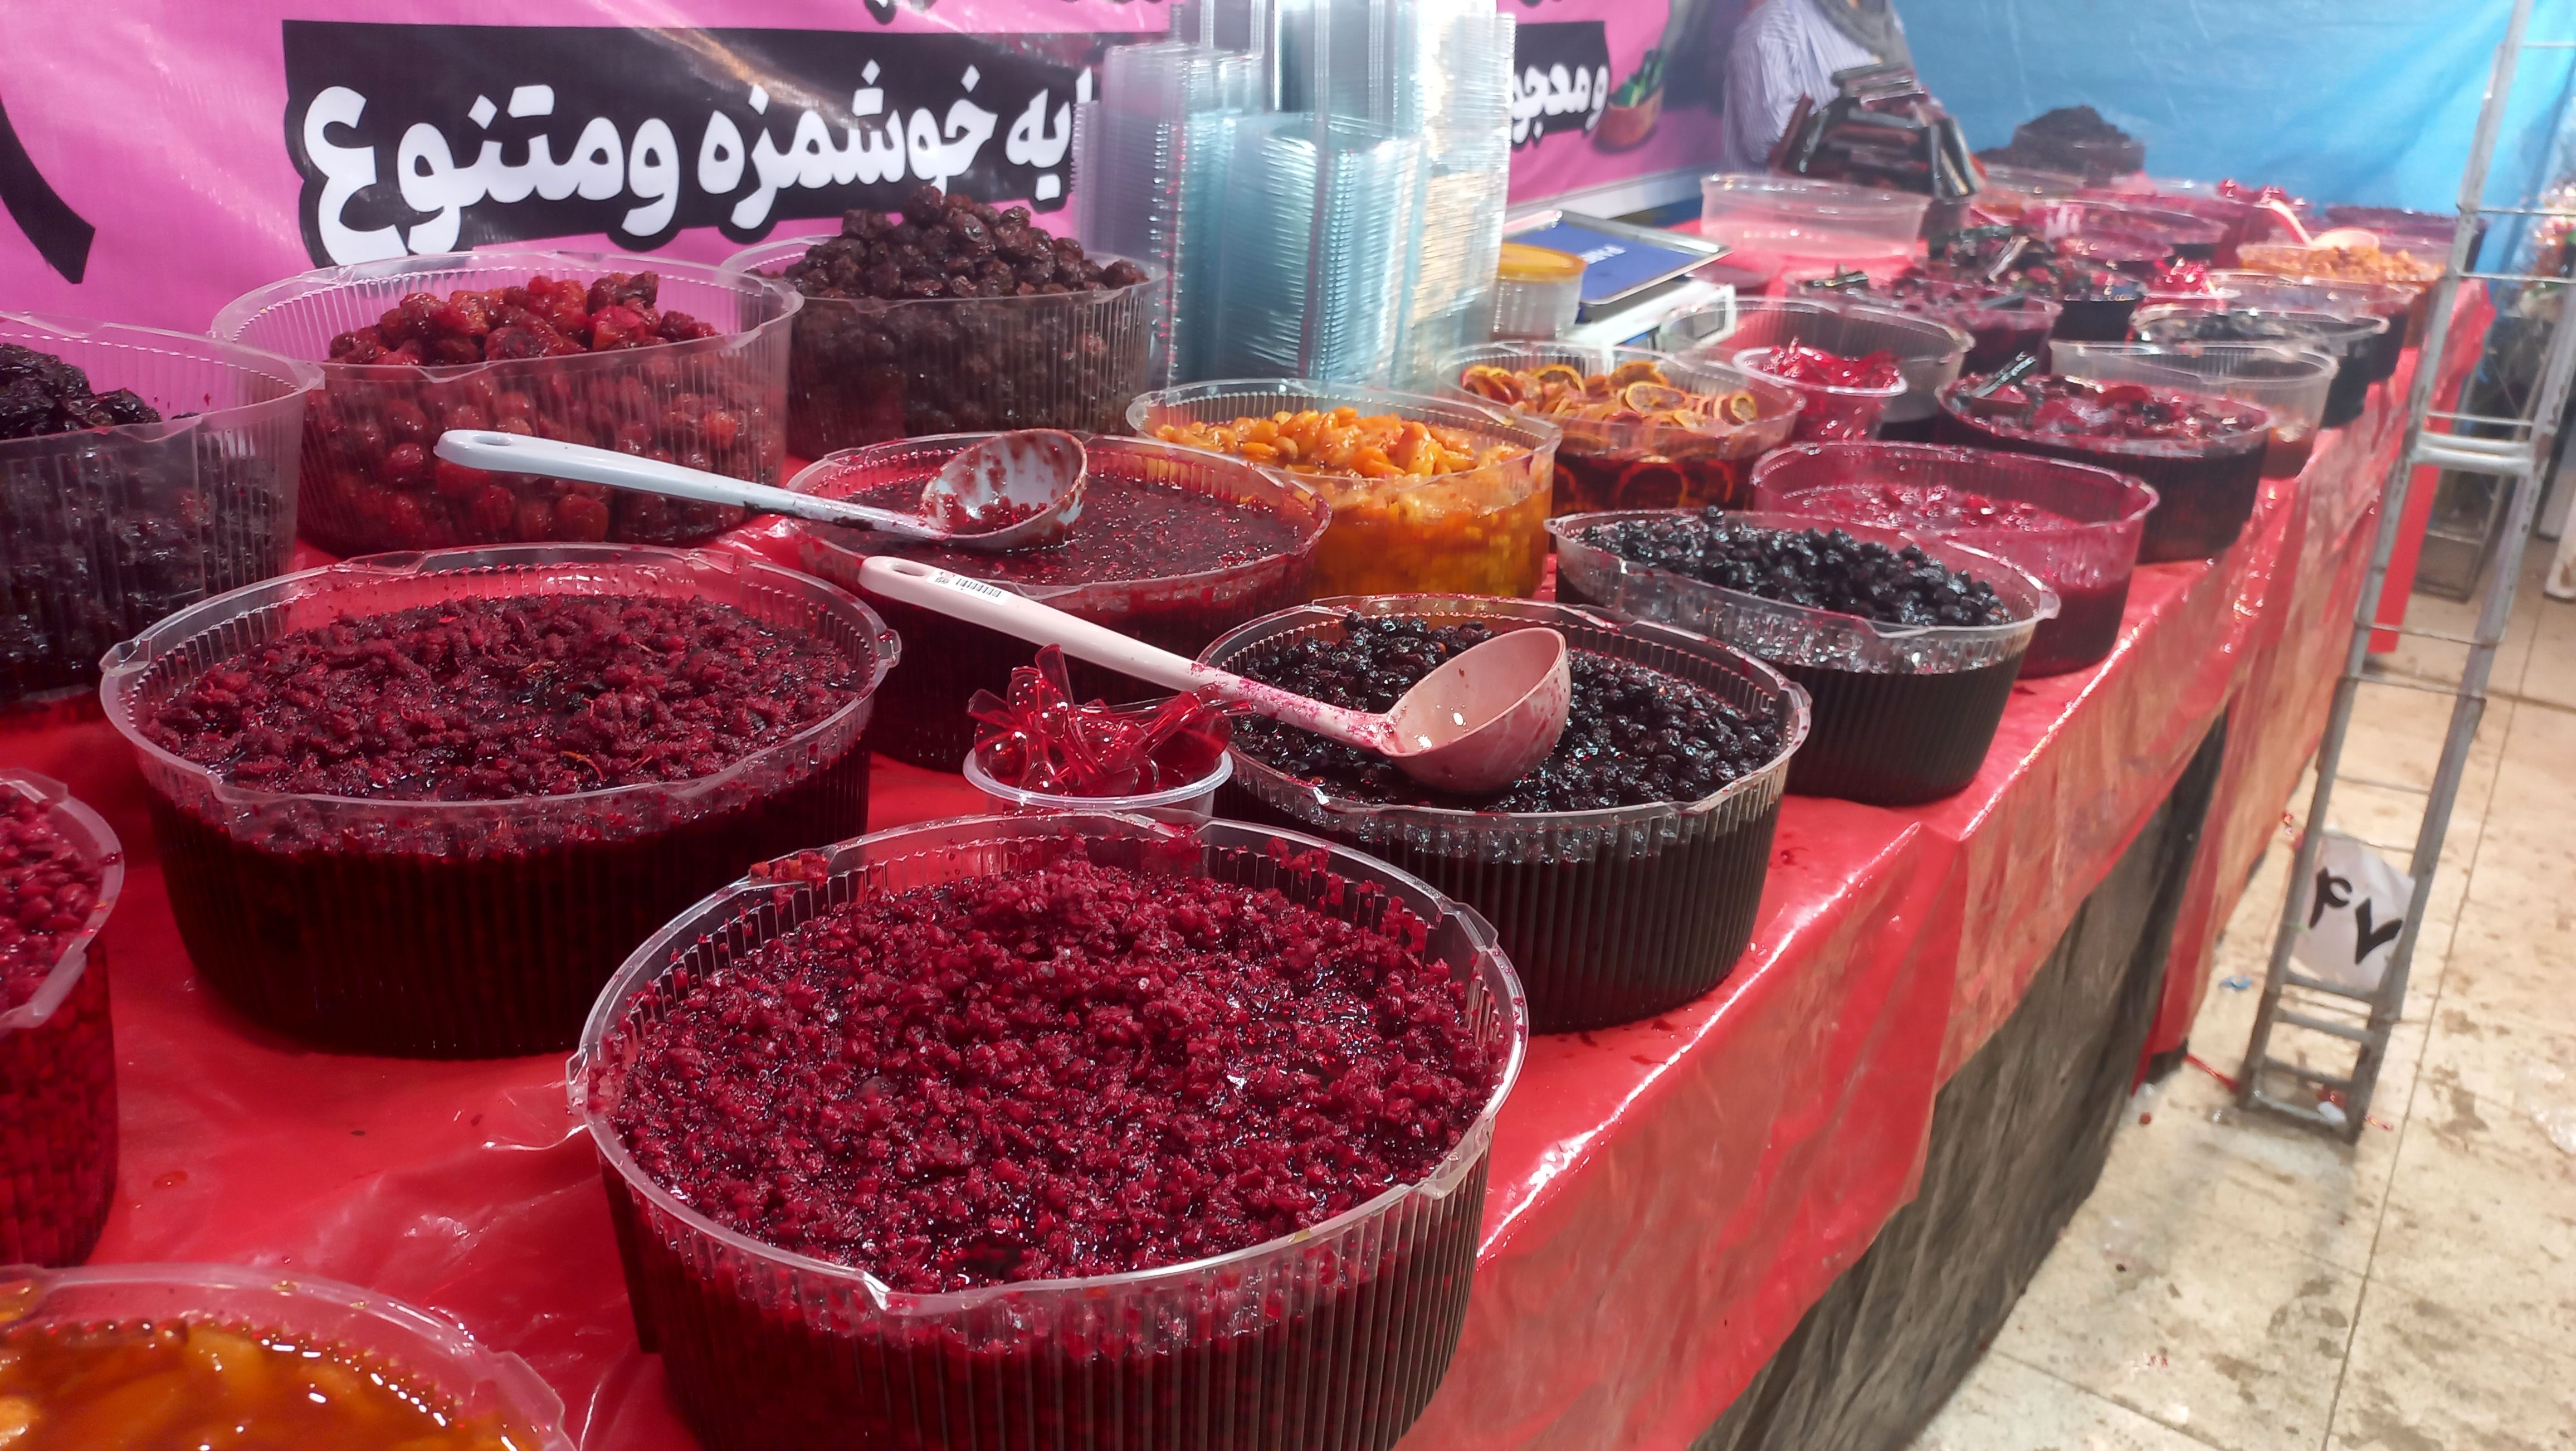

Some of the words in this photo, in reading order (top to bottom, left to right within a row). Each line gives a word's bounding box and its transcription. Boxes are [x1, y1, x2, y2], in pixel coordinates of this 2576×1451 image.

[304, 84, 680, 266] ومتنوع
[697, 58, 998, 230] خوشمزه
[1512, 62, 1609, 144] ومعجو
